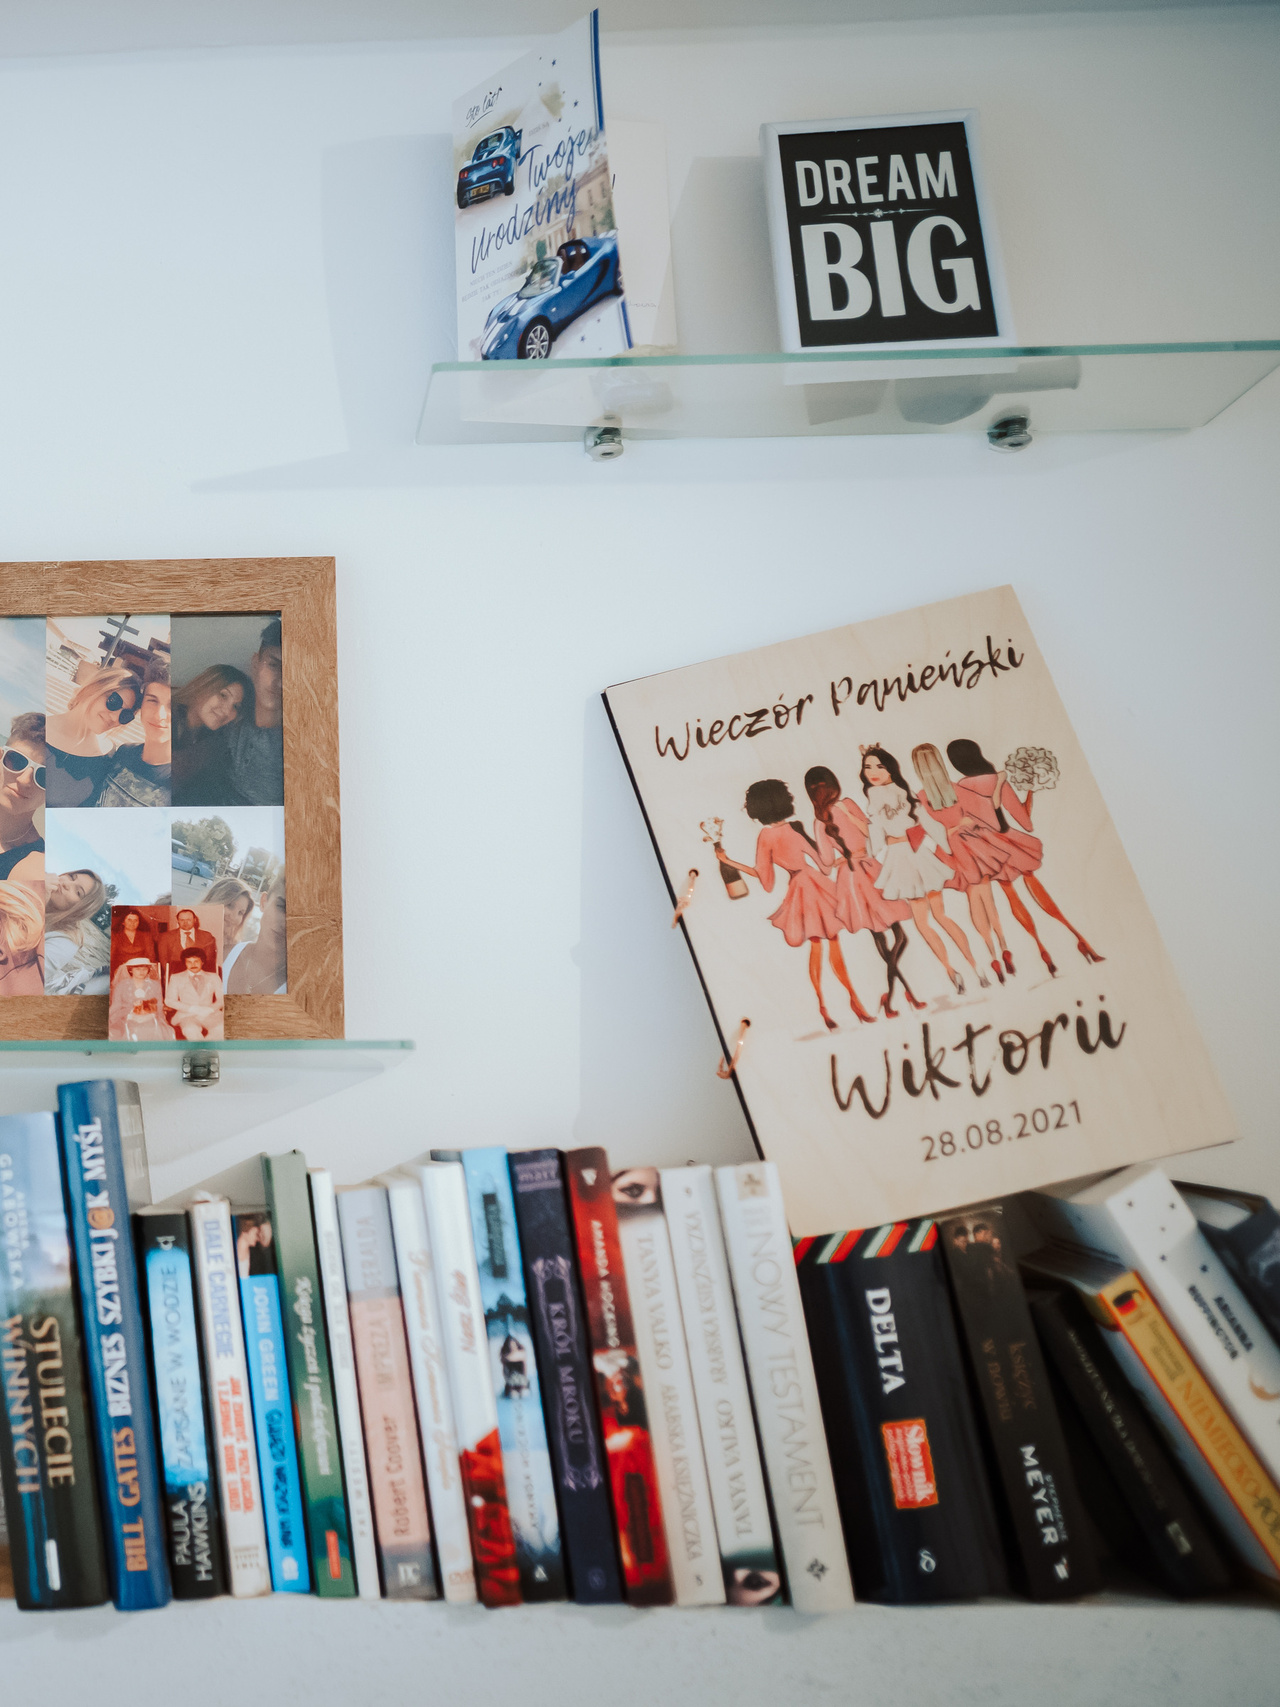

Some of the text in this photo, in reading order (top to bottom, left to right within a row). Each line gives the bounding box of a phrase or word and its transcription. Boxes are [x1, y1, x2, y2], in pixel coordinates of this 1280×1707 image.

[465, 105, 483, 128] Sto
[517, 127, 597, 191] Twoje
[471, 178, 577, 274] Urodziny
[795, 150, 959, 207] DREAM
[800, 215, 982, 321] BIG
[656, 635, 1024, 761] Wieczór Panieński
[830, 995, 1127, 1120] Wiktorii
[920, 1100, 1083, 1163] 28.08.2021
[203, 1220, 234, 1359] DALE CARNEGIE
[591, 1220, 621, 1349] AMANDA HOCKING
[72, 1117, 148, 1572] BILL GATES BIZNES SZYBKI MYŚL
[160, 1267, 194, 1471] ZAPISANE W WODZIE
[252, 1286, 278, 1401] JOHN GREEN
[548, 1302, 585, 1445] KRÓL MROKU
[702, 1318, 729, 1385] ARABSKA
[752, 1231, 825, 1530] NOWY TESTAMENT
[865, 1287, 906, 1396] DELTA
[29, 1316, 76, 1487] STULECIE
[636, 1234, 704, 1561] TANYA VALKO ARABSKA KSIĘŻNICZKA
[716, 1400, 748, 1471] VALKO
[381, 1414, 411, 1537] Robert Coover
[728, 1472, 754, 1539] TANYA
[906, 1424, 935, 1503] Słownik
[1020, 1444, 1060, 1545] MEYER
[1045, 1474, 1069, 1543] STEPHENIE
[169, 1499, 191, 1567] PAULA
[184, 1480, 215, 1583] HAWKINS
